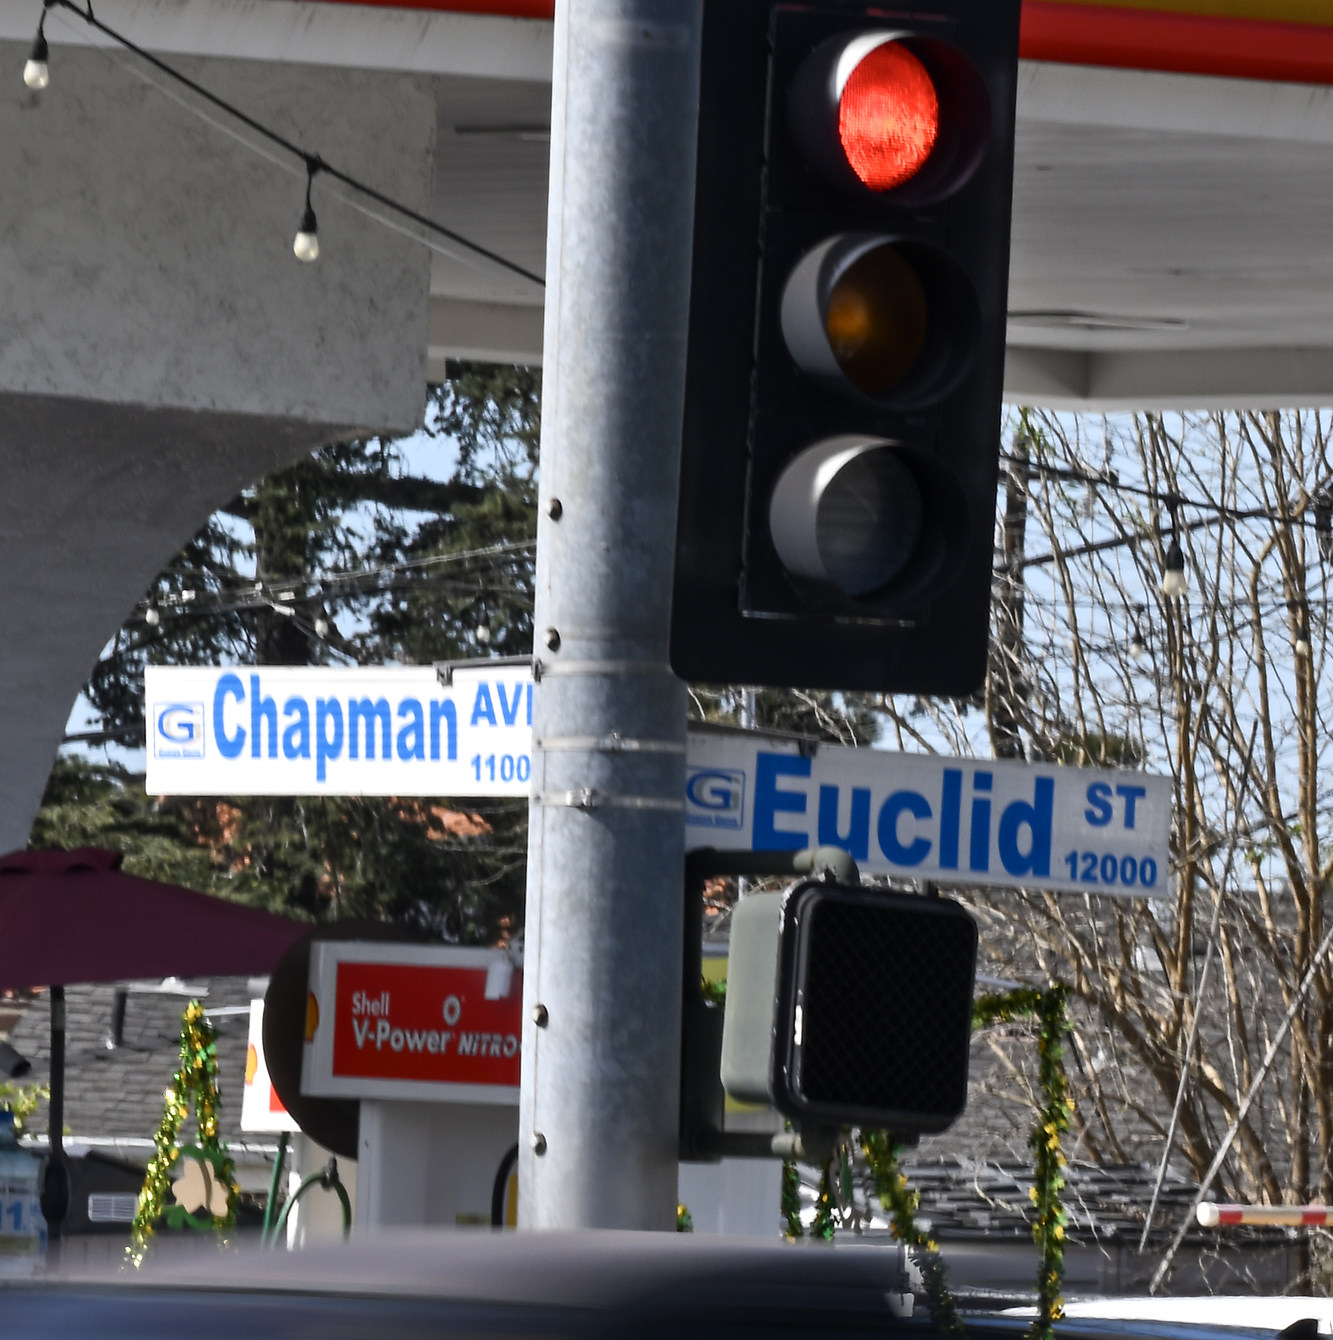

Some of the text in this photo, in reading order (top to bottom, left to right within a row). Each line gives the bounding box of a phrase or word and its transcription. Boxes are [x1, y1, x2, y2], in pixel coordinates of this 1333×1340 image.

[213, 671, 532, 783] Chapman AV
[752, 752, 1146, 878] Euclid ST
[1065, 850, 1157, 888] 12000
[352, 990, 390, 1017] Shell
[352, 1017, 450, 1054] V-Power
